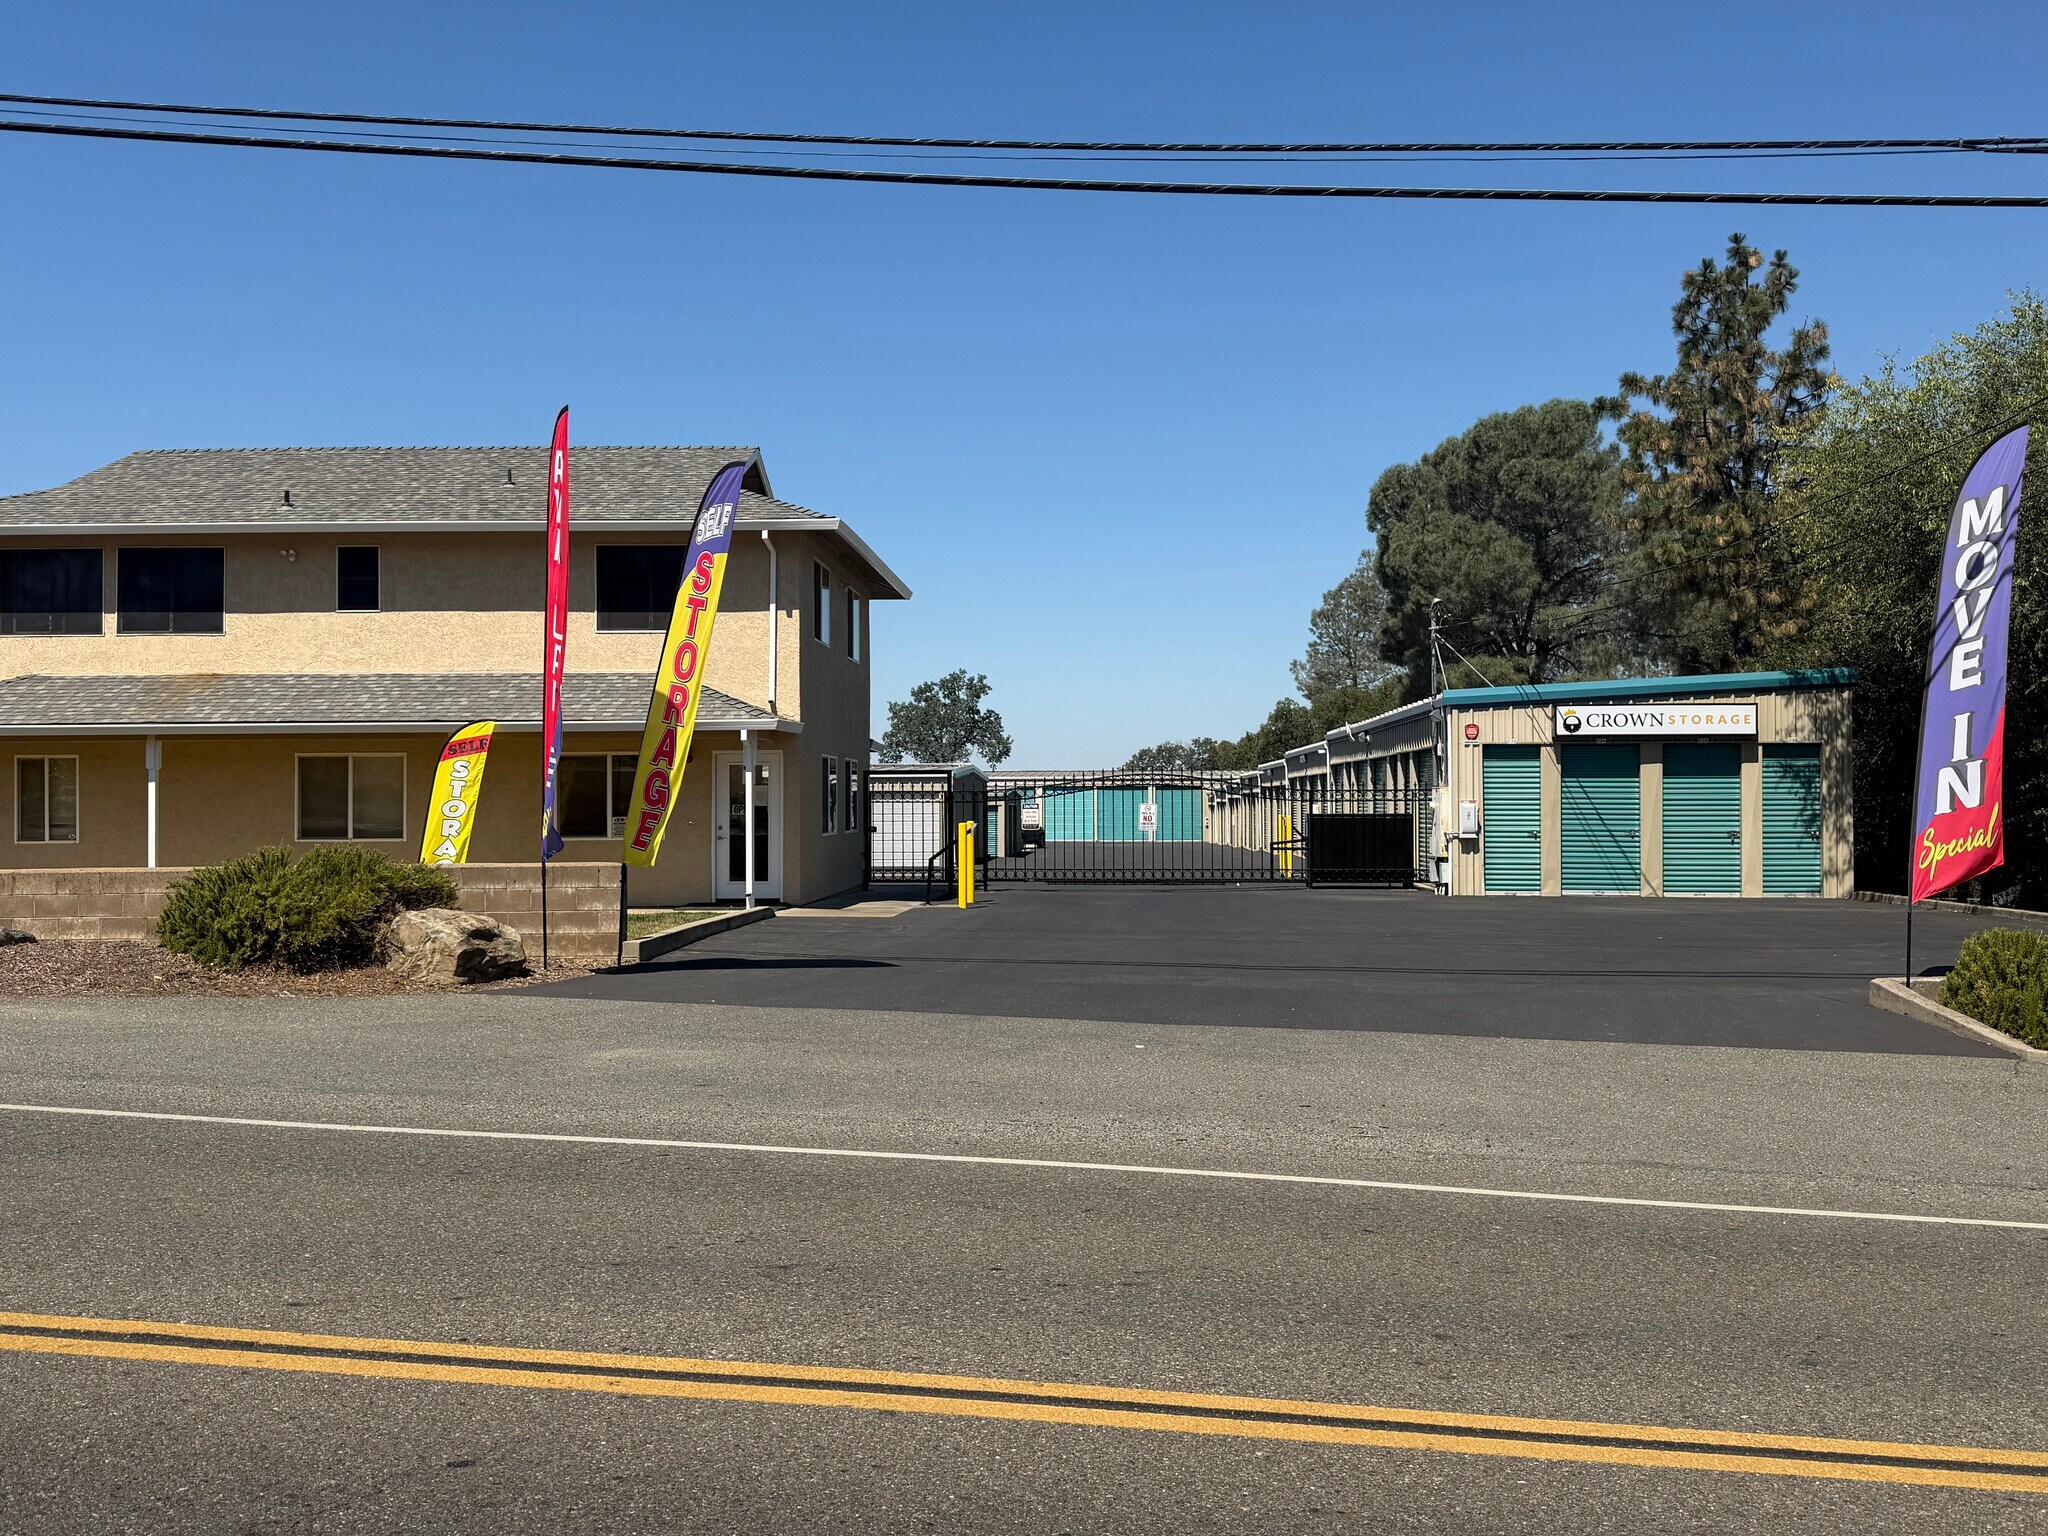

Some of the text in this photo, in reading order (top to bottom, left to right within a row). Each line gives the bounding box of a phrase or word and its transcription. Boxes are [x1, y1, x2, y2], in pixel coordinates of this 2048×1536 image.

[696, 502, 733, 545] SELF
[1934, 484, 2005, 816] MOVE IN
[630, 550, 716, 852] STORAGE
[1586, 712, 1752, 728] CROWN STORAGE
[447, 738, 489, 756] SELF
[432, 759, 471, 864] STORA
[733, 805, 746, 814] OP
[1918, 801, 2000, 882] Special
